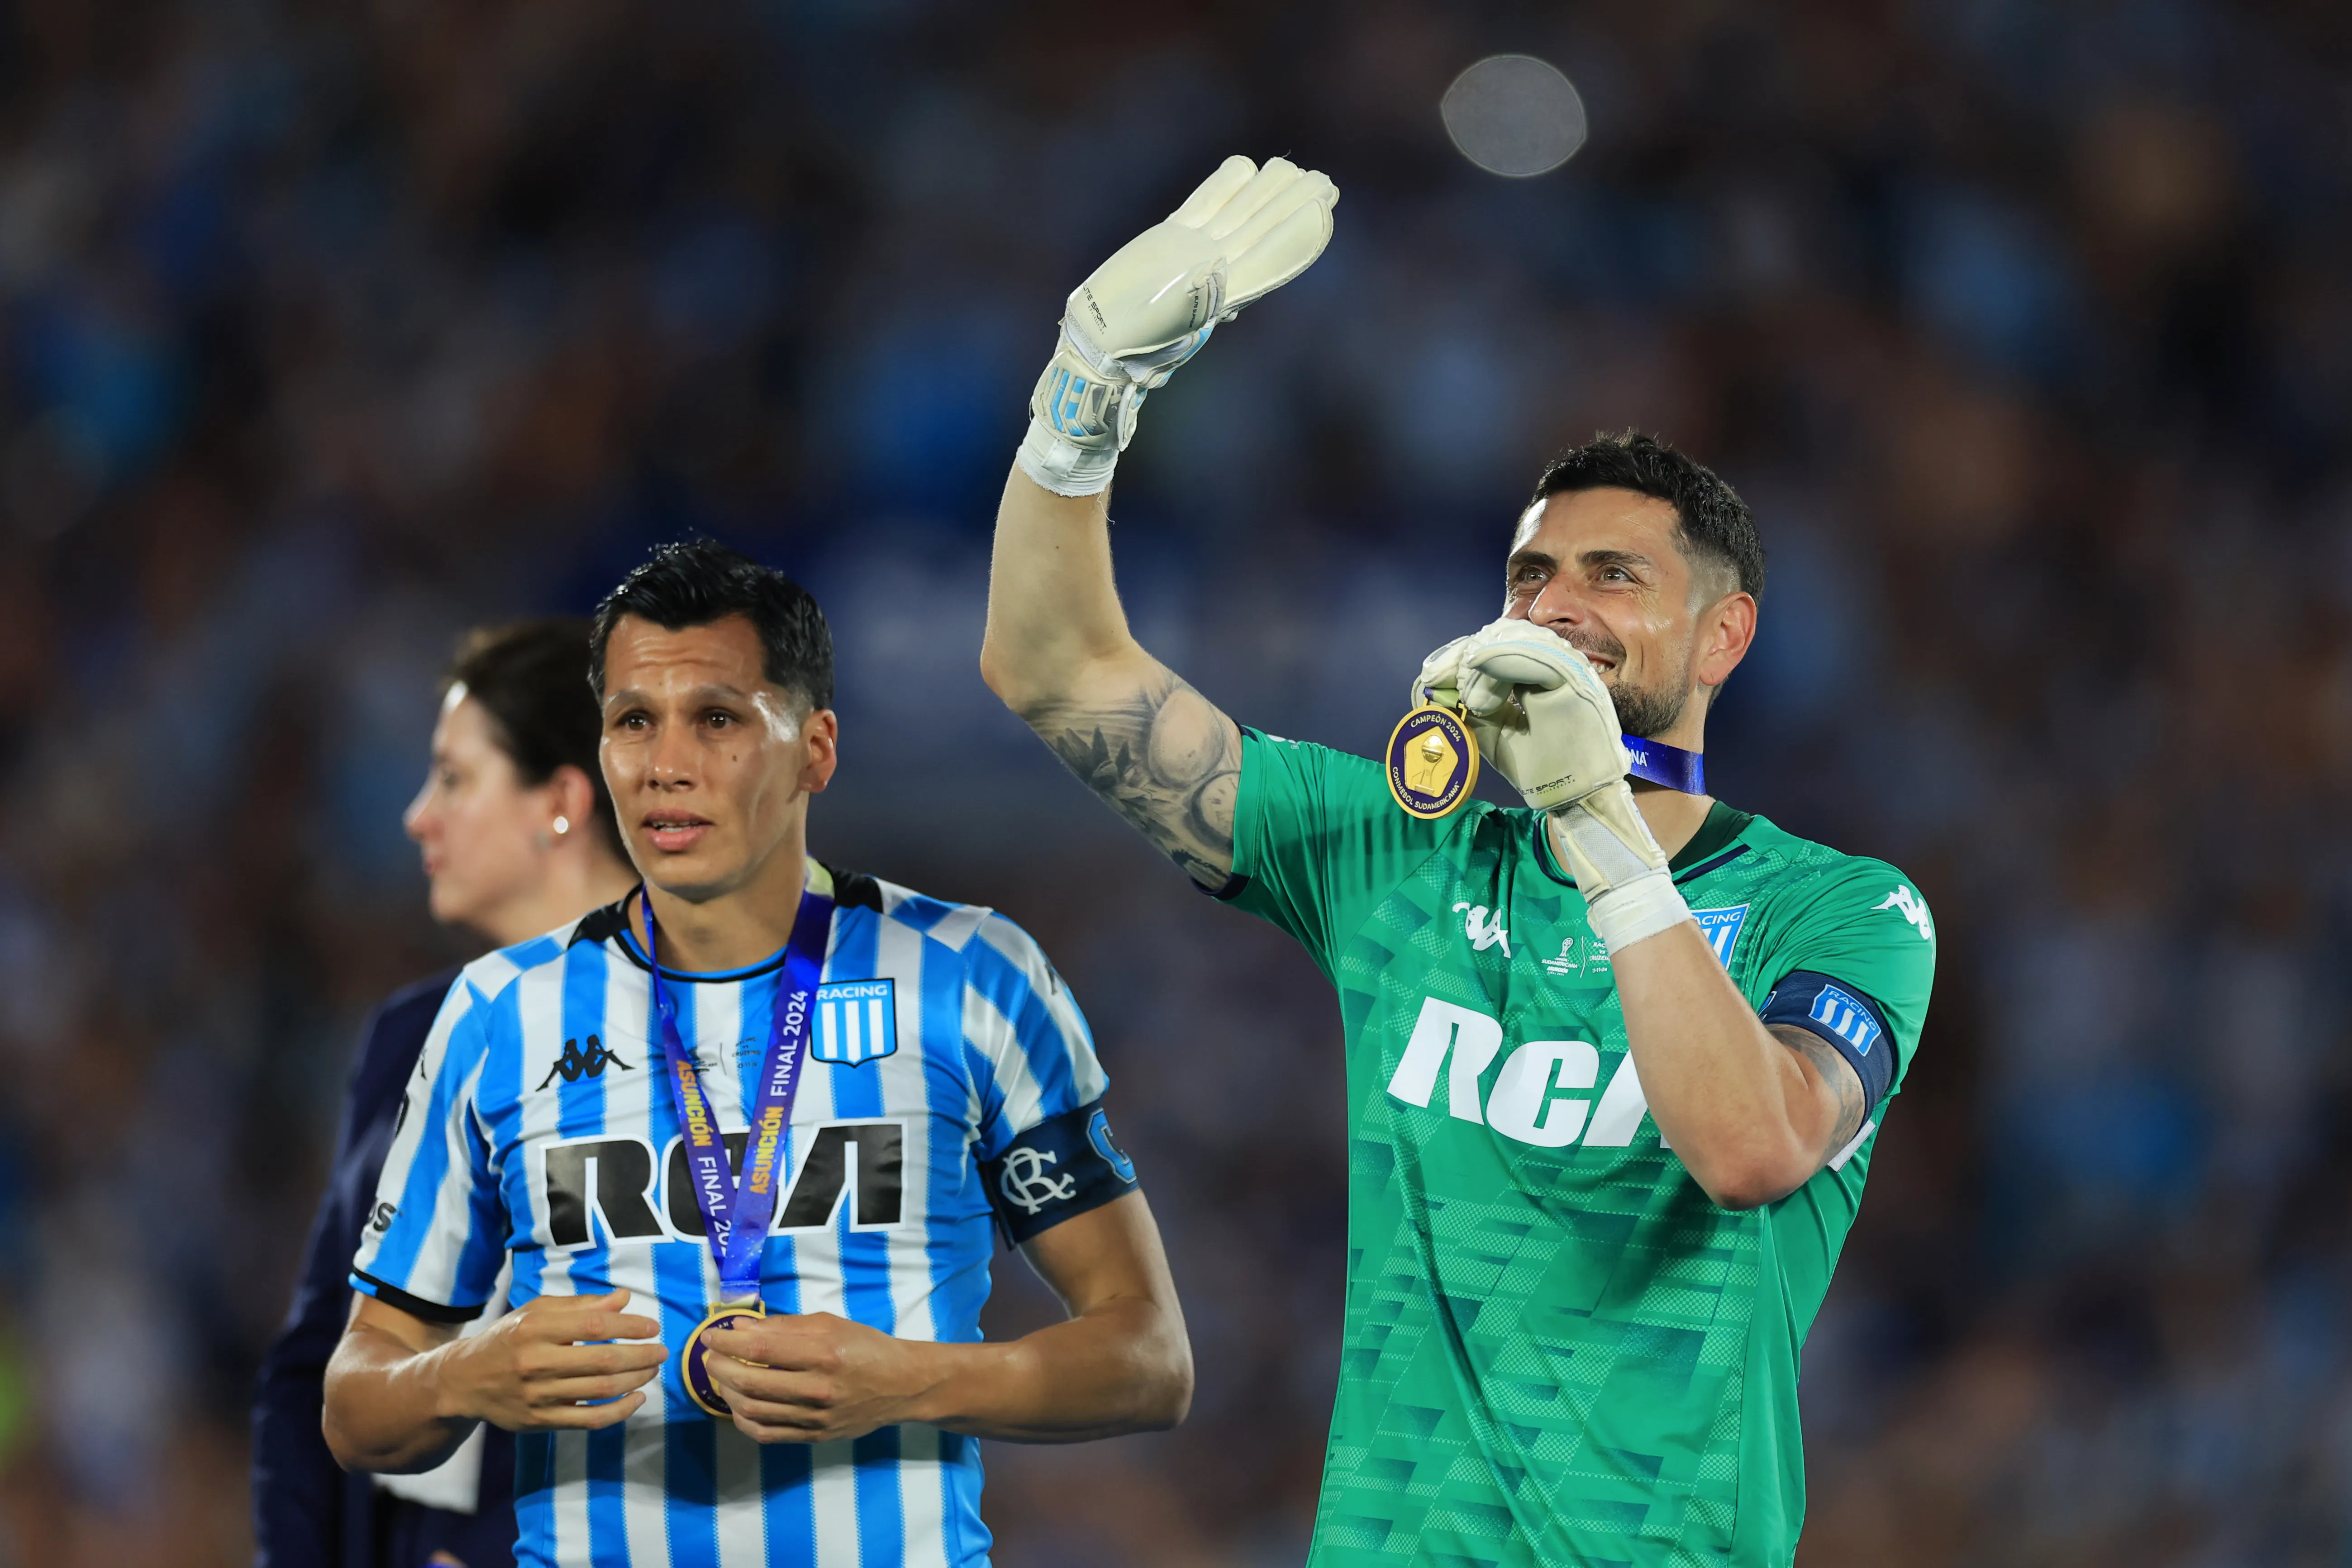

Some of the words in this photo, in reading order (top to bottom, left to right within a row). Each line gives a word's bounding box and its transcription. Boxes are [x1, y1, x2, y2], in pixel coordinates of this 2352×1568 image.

[1091, 302, 1107, 328] SPORT
[1411, 714, 1447, 727] CAMPEÓN
[1446, 722, 1461, 742] 2024
[1392, 767, 1413, 805] CONMEBOL
[1536, 774, 1572, 792] SPORT
[1694, 911, 1741, 926] ACING
[1541, 959, 1578, 969] SUDAMERICANA
[816, 984, 888, 1000] RACING
[783, 990, 809, 1036] 2024
[1828, 990, 1876, 1031] RACING
[770, 1038, 799, 1097] FINAL
[676, 1060, 714, 1146] ASUNCIÓN
[697, 1156, 727, 1216] FINAL
[749, 1106, 785, 1194] ASUNCIÓN
